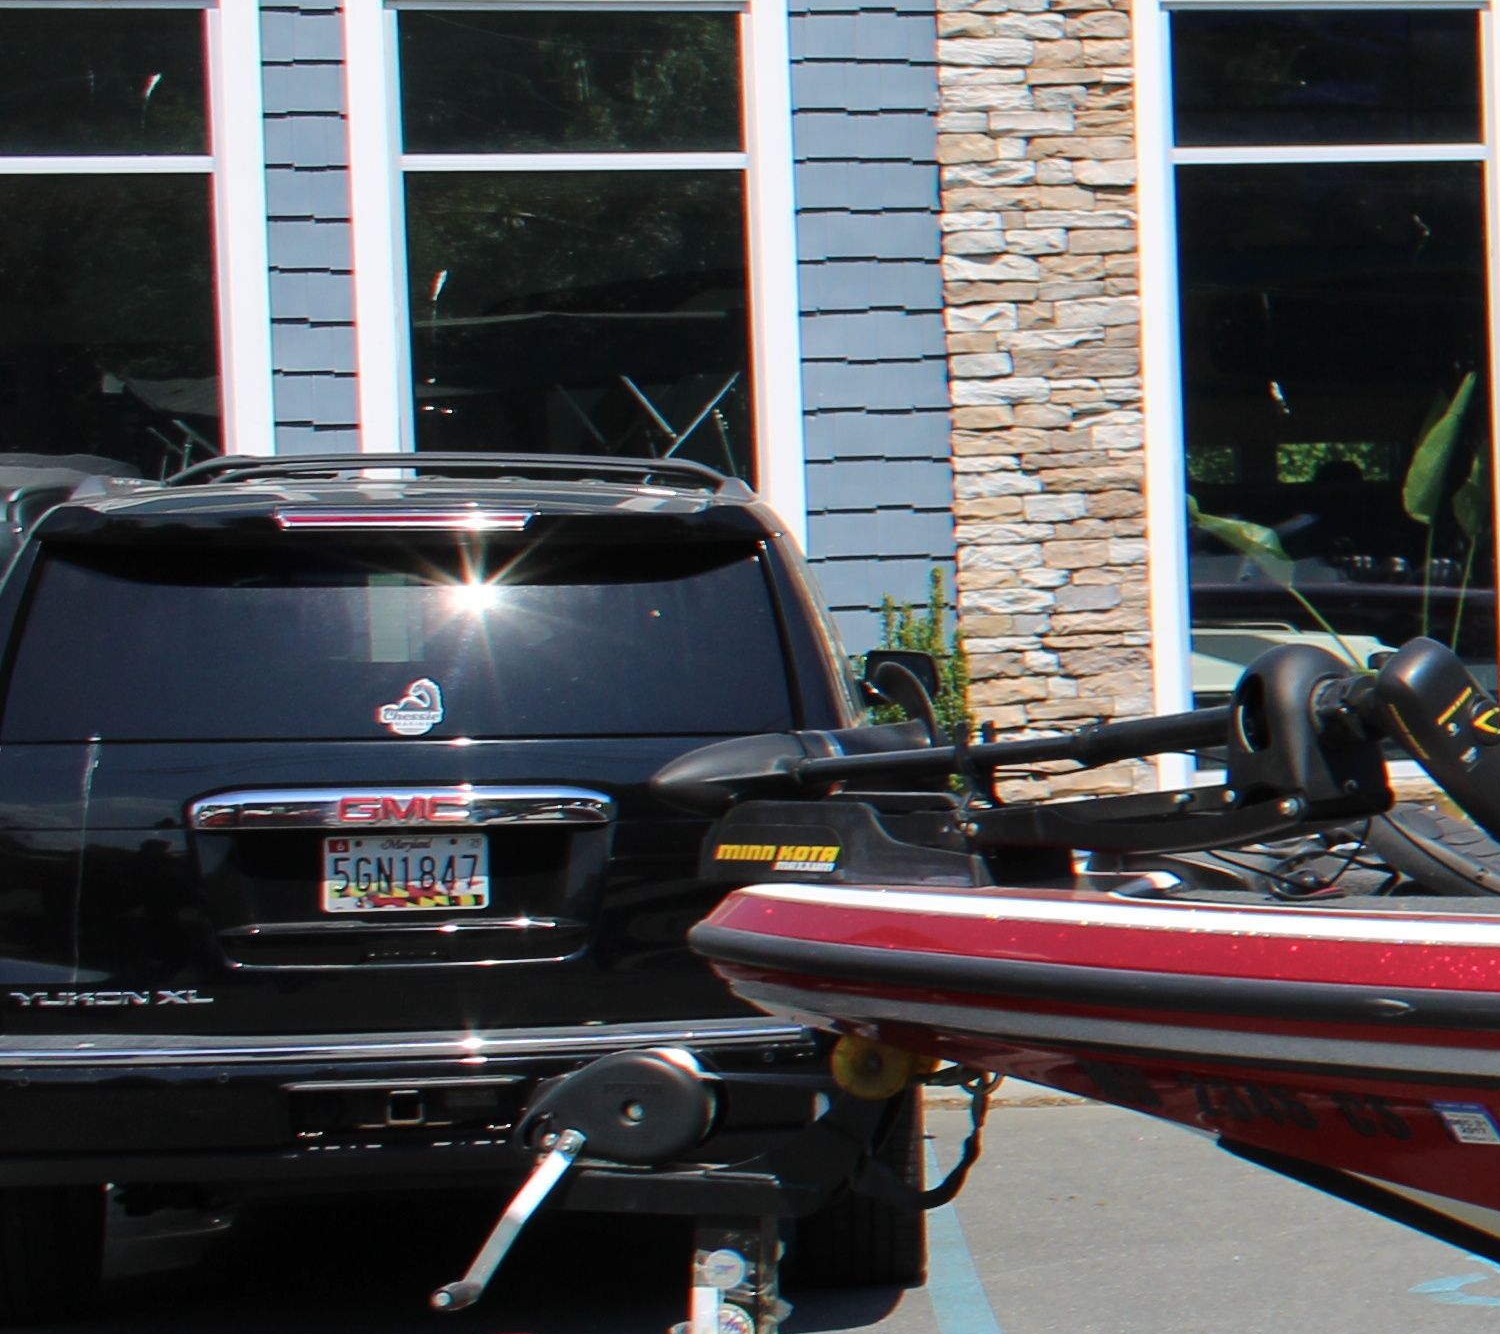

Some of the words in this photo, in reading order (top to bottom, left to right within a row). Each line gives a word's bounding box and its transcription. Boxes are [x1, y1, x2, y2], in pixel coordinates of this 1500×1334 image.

[338, 797, 469, 822] GMC
[776, 845, 840, 862] KOTA
[334, 855, 478, 893] 5GN1847
[10, 990, 150, 1006] YUKON
[156, 989, 214, 1005] XL
